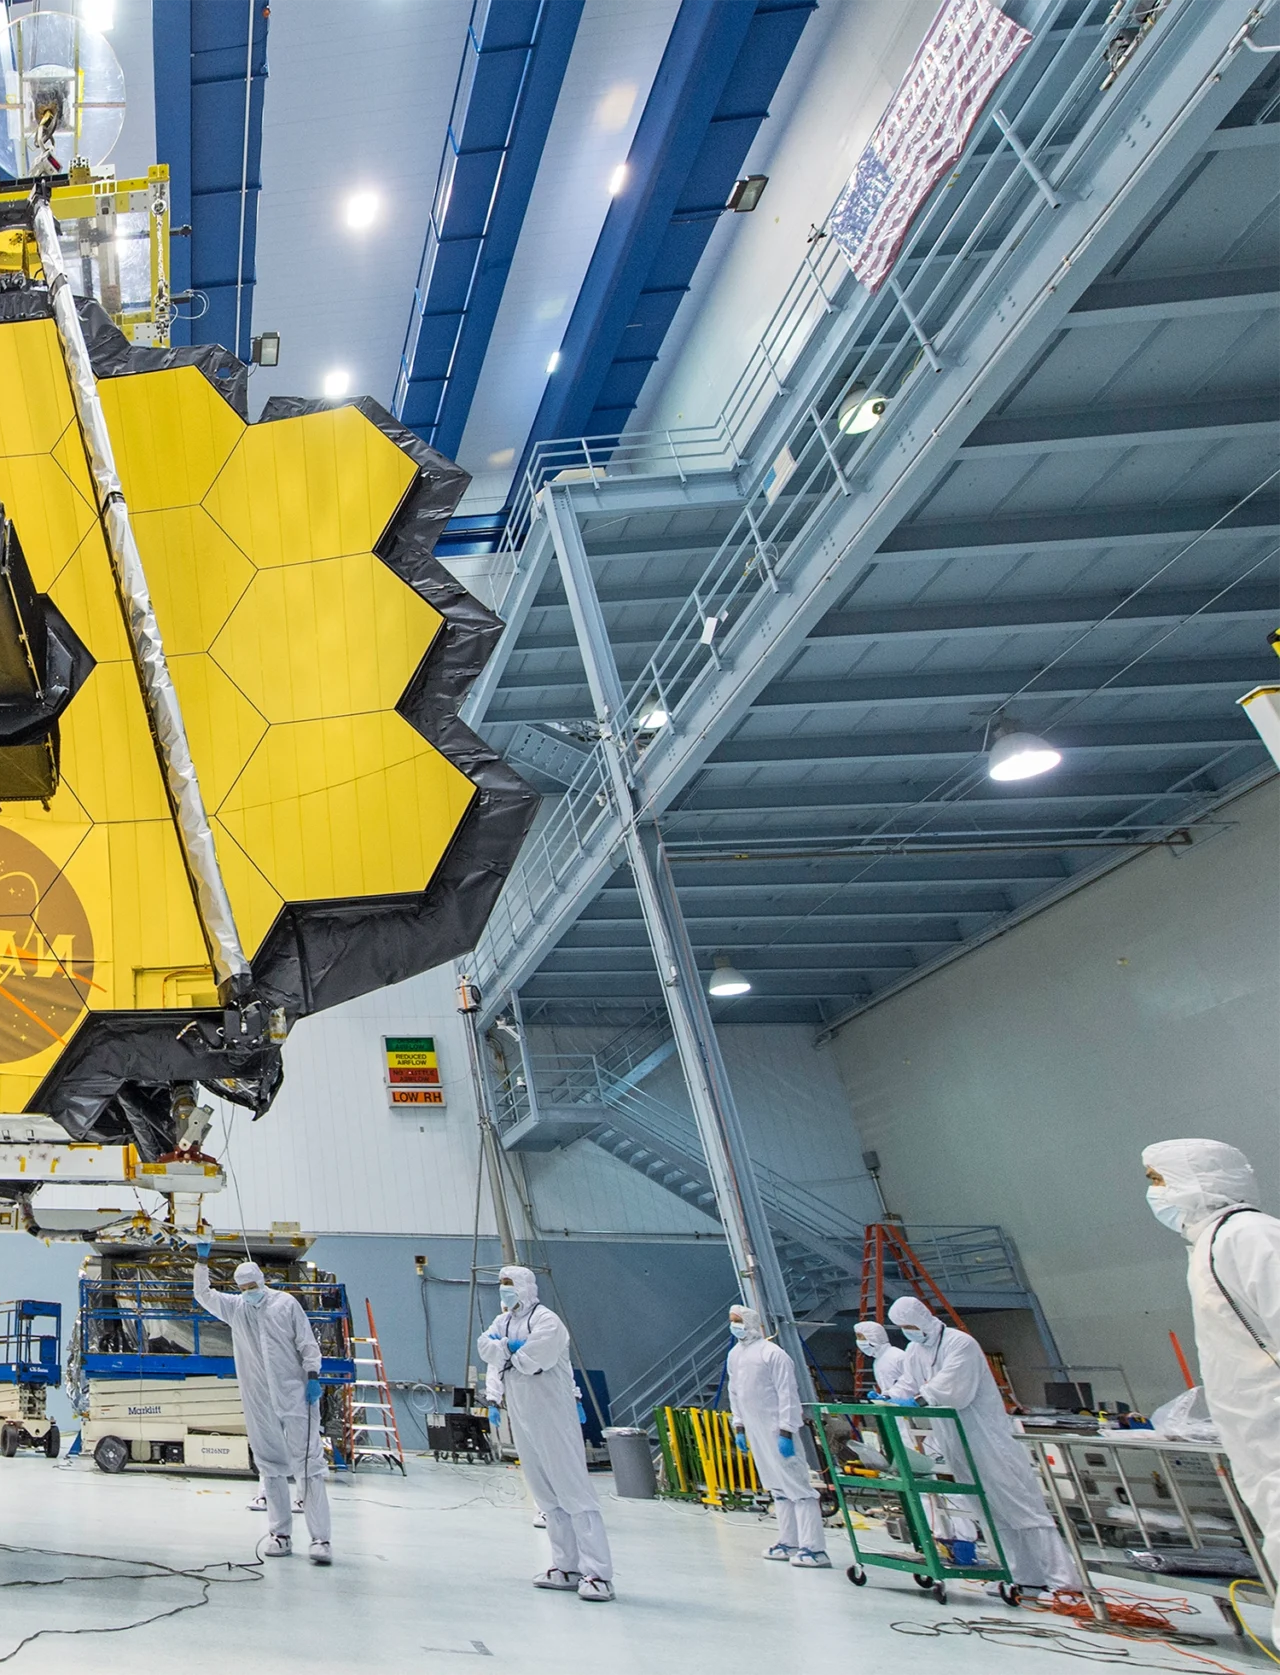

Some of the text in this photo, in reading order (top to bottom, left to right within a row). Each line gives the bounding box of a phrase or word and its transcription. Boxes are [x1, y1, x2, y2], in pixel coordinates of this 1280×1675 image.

[392, 1092, 442, 1103] LOW RH
[128, 1405, 162, 1416] Marklift
